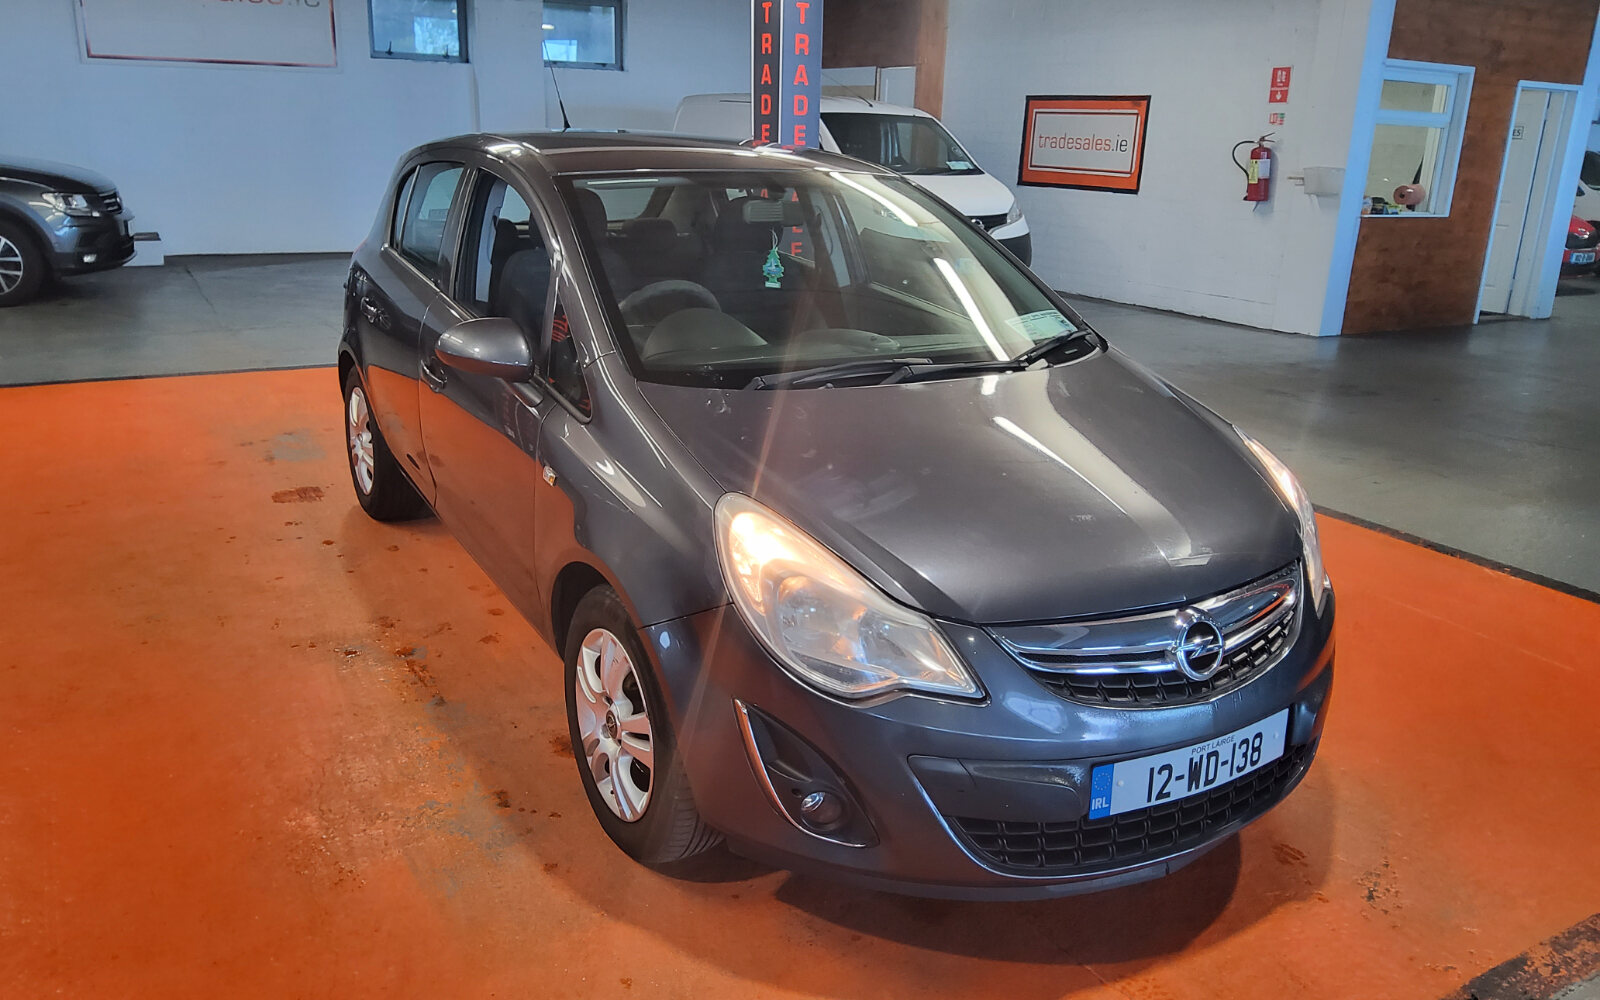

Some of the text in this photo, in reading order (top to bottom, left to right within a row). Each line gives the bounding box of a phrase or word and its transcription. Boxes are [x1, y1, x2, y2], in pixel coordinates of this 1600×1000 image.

[761, 2, 772, 143] TRADE
[793, 2, 810, 146] TRADE
[1038, 132, 1128, 152] tradesales.ie
[1147, 732, 1263, 803] 12-WD-138
[1191, 743, 1211, 755] PORT
[1091, 797, 1109, 811] IRL
